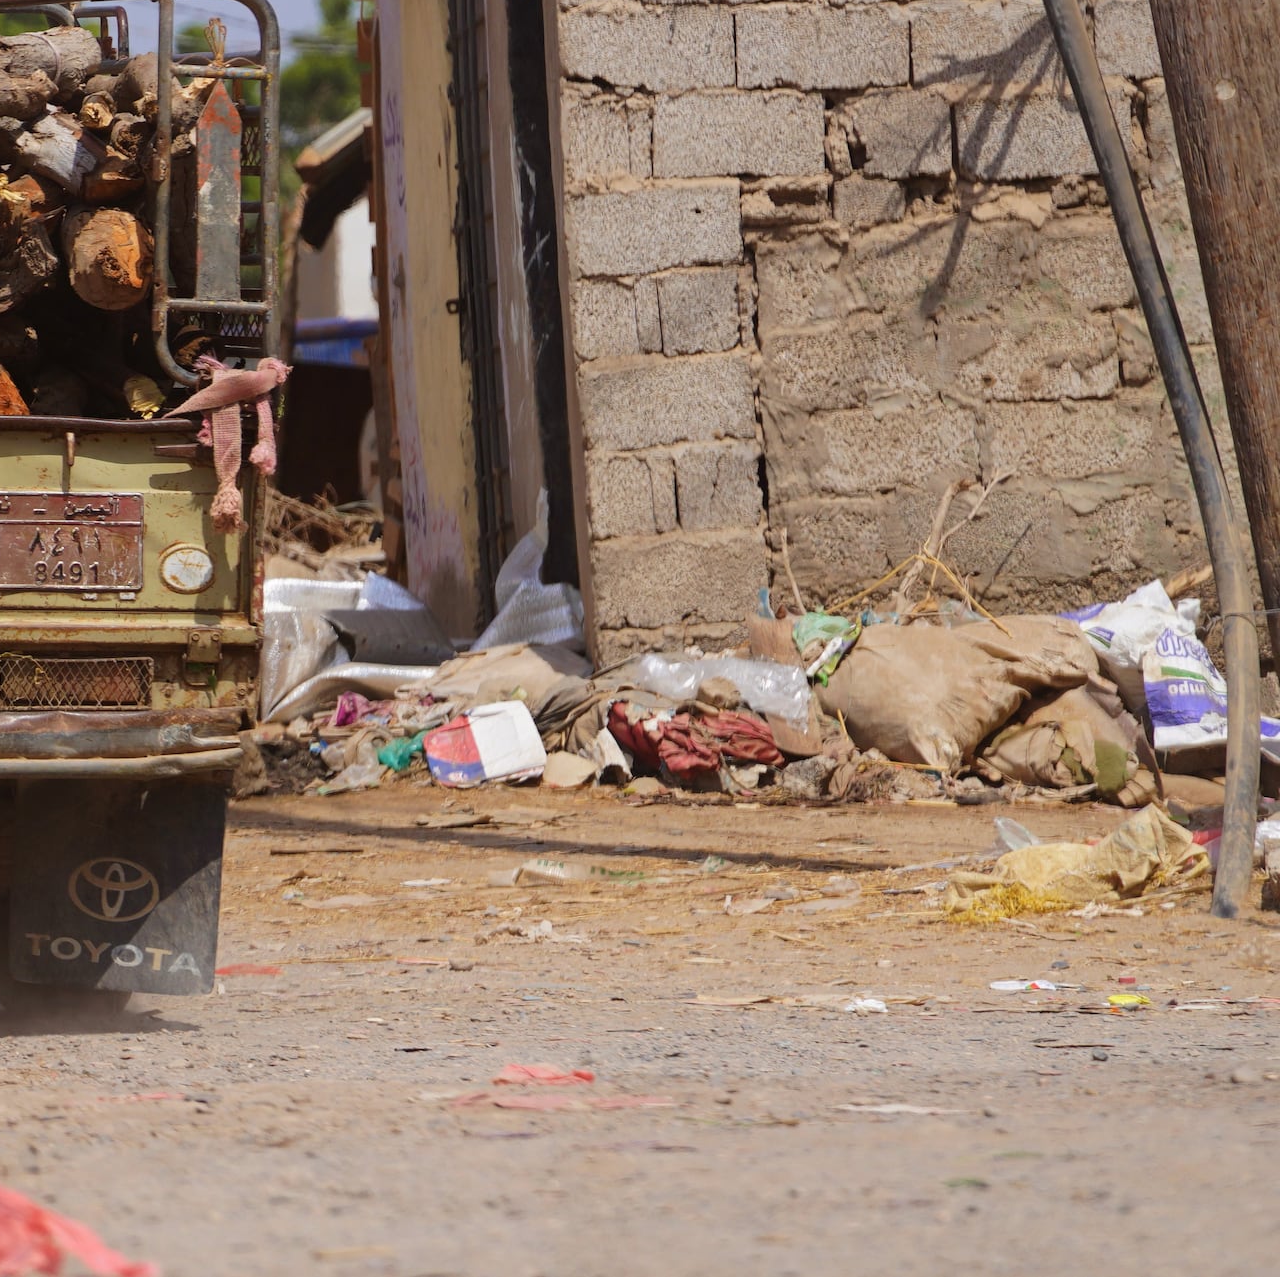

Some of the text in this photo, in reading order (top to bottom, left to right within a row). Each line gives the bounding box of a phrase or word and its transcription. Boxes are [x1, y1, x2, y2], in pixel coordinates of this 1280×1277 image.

[64, 497, 119, 521] اليمن
[28, 527, 102, 556] ٨٤٩١
[34, 560, 100, 584] 8491
[24, 932, 203, 978] TOYOTA
